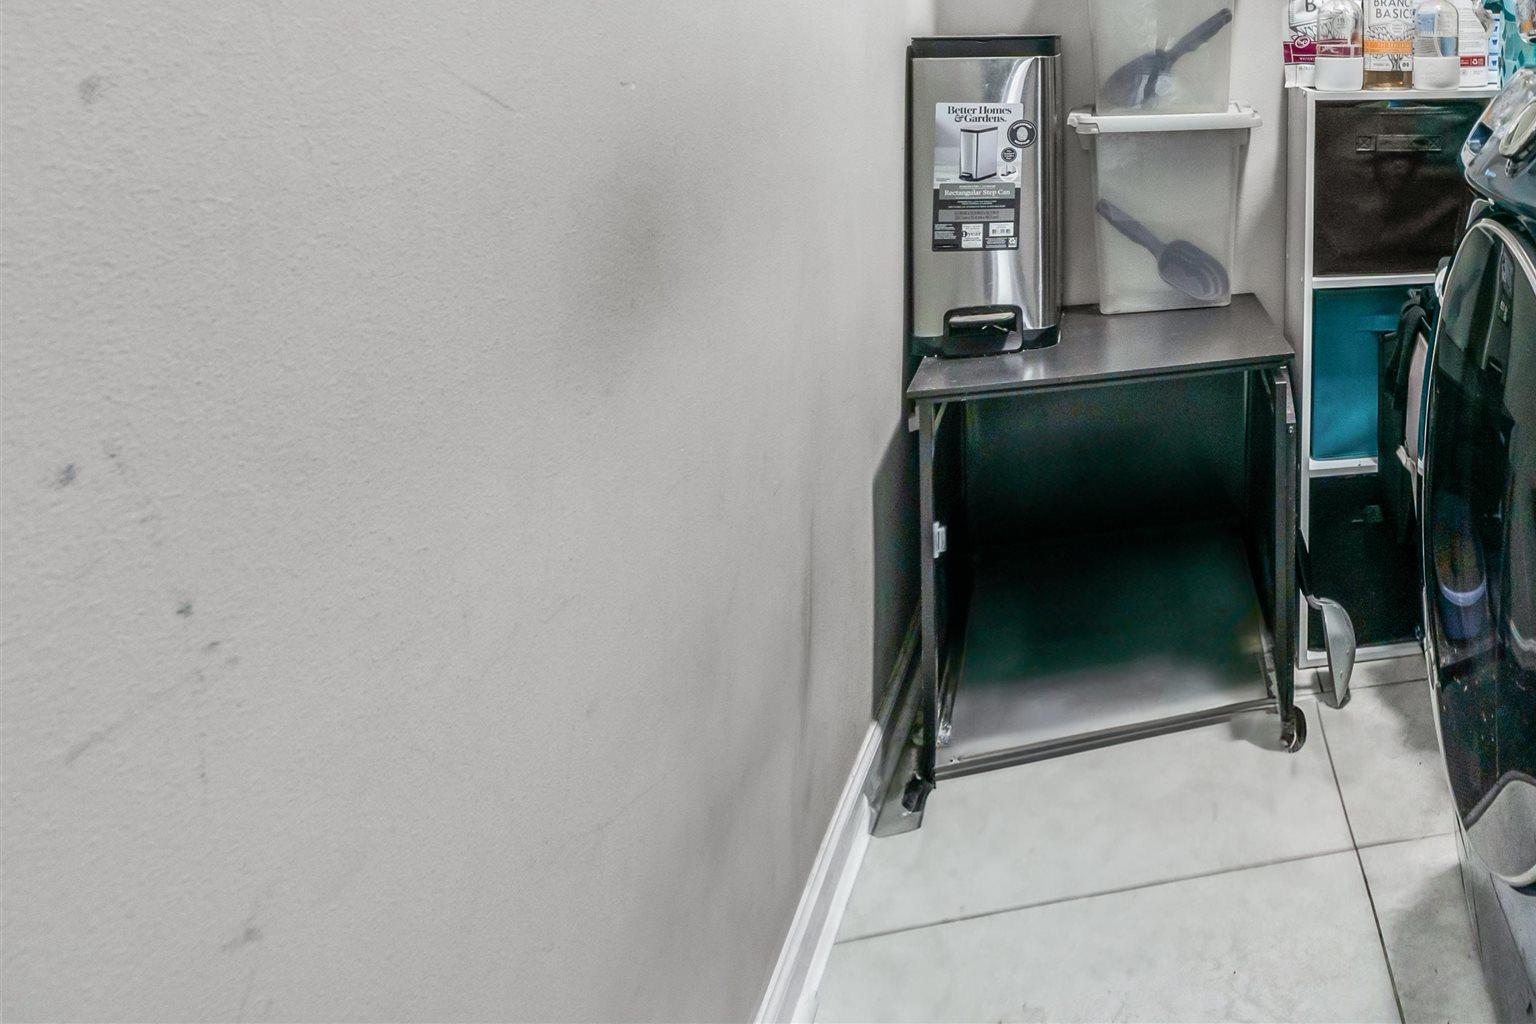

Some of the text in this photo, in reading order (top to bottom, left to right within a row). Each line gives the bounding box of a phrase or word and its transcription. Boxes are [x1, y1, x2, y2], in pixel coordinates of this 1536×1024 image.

[947, 105, 1012, 115] Better Homes
[954, 114, 964, 123] &
[944, 189, 982, 197] Rectangular
[982, 189, 997, 197] Step
